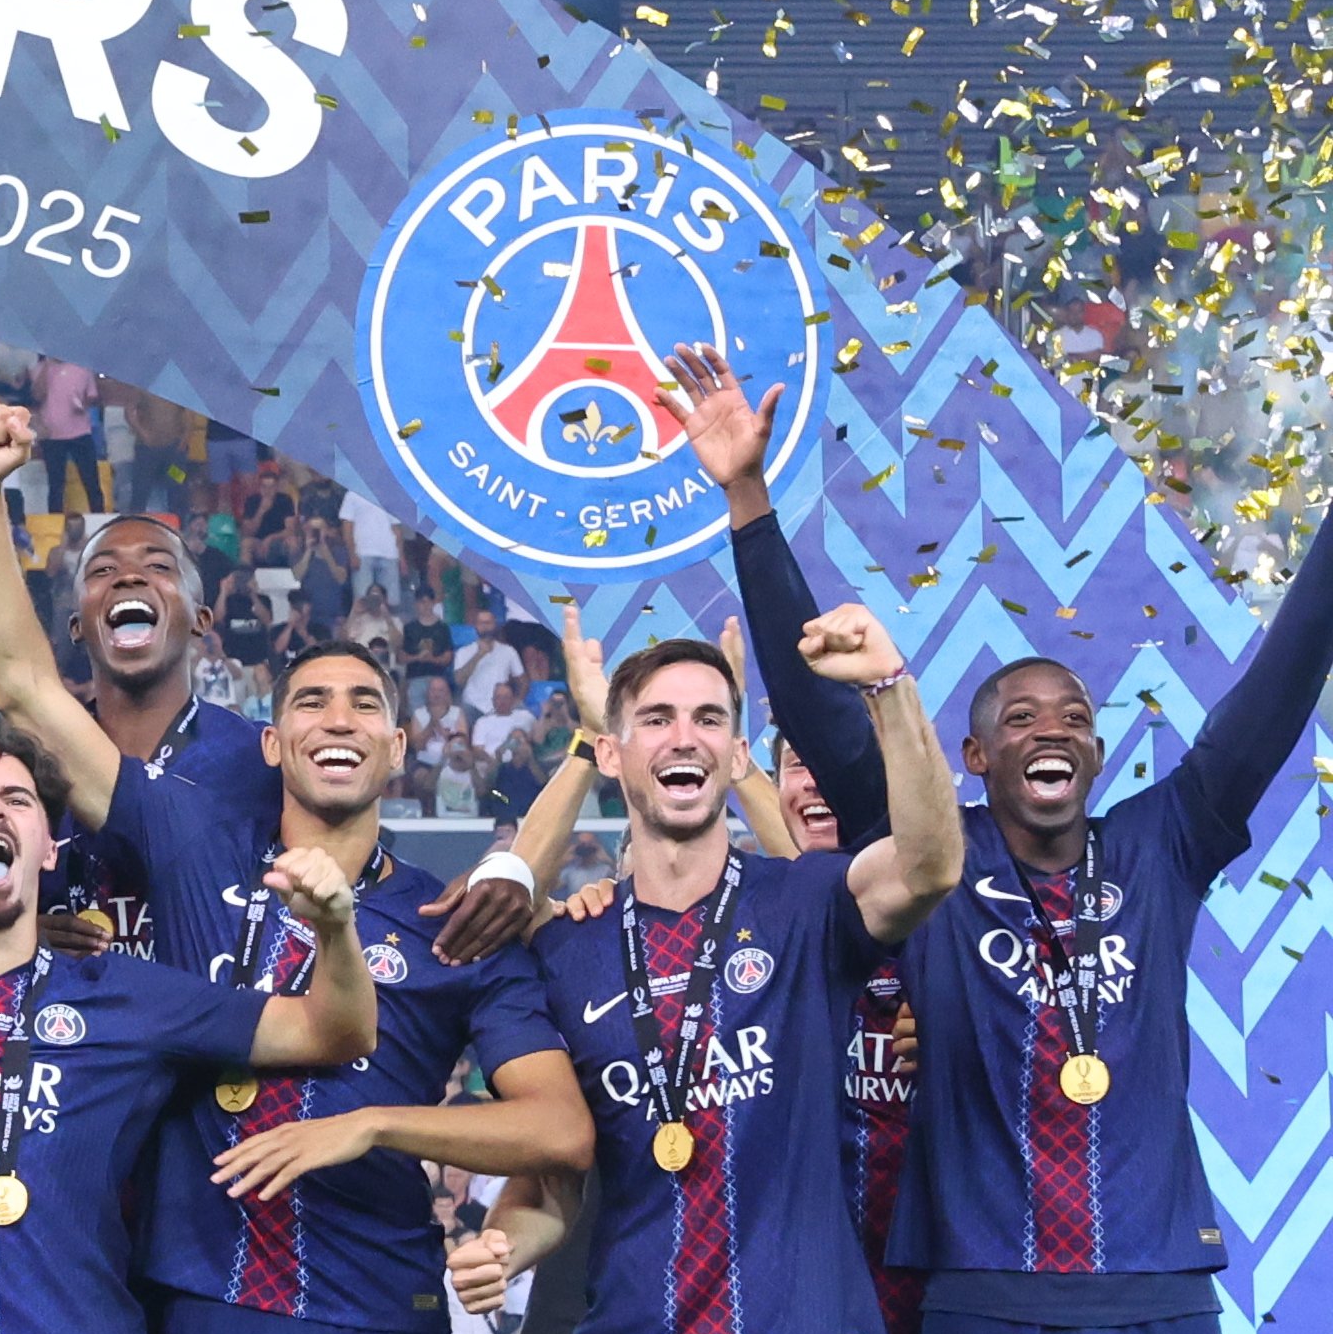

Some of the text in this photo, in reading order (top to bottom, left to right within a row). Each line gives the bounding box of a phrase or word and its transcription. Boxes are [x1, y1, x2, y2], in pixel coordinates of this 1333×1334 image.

[448, 146, 739, 253] PARIS
[448, 440, 547, 518] SAINT
[579, 467, 717, 529] GERMAI
[42, 1005, 76, 1019] PARIS
[600, 1025, 774, 1107] QAR
